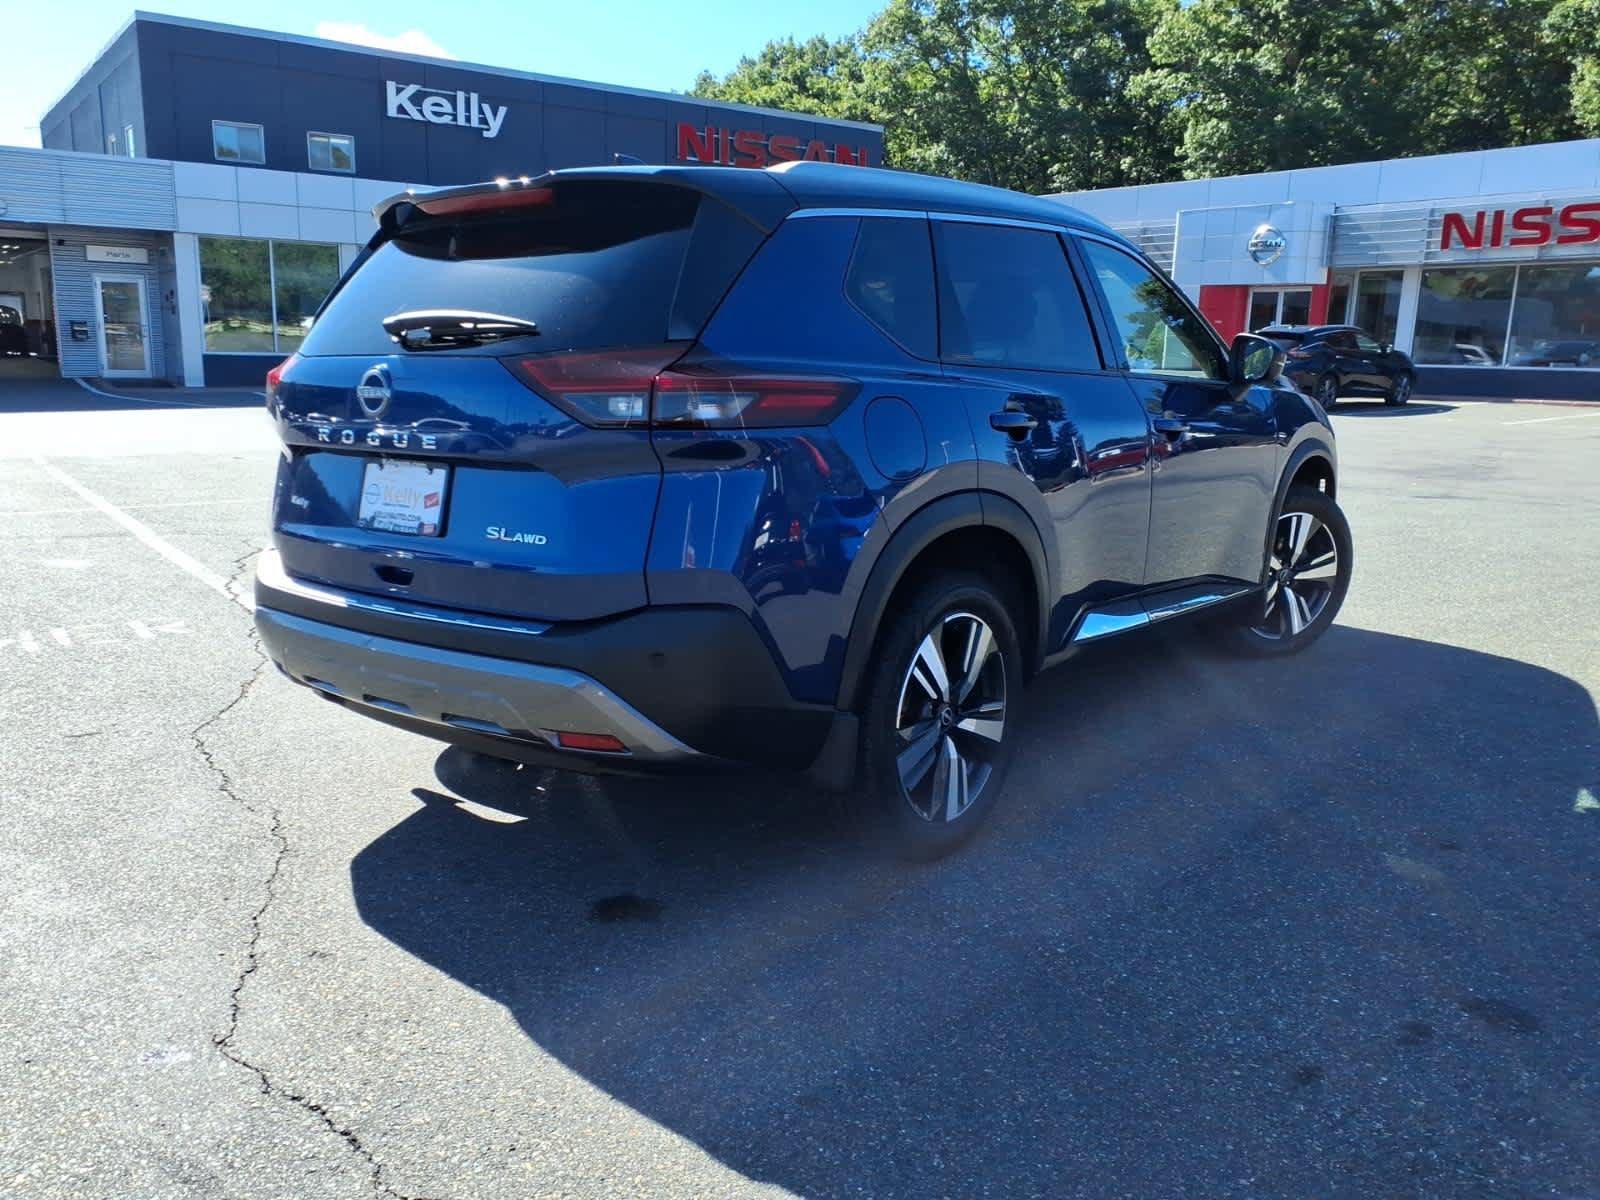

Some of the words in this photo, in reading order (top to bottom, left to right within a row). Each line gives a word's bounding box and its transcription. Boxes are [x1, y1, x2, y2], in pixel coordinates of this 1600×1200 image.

[386, 80, 507, 138] Kelly
[677, 122, 868, 169] NISSAN
[318, 427, 437, 450] ROGUE
